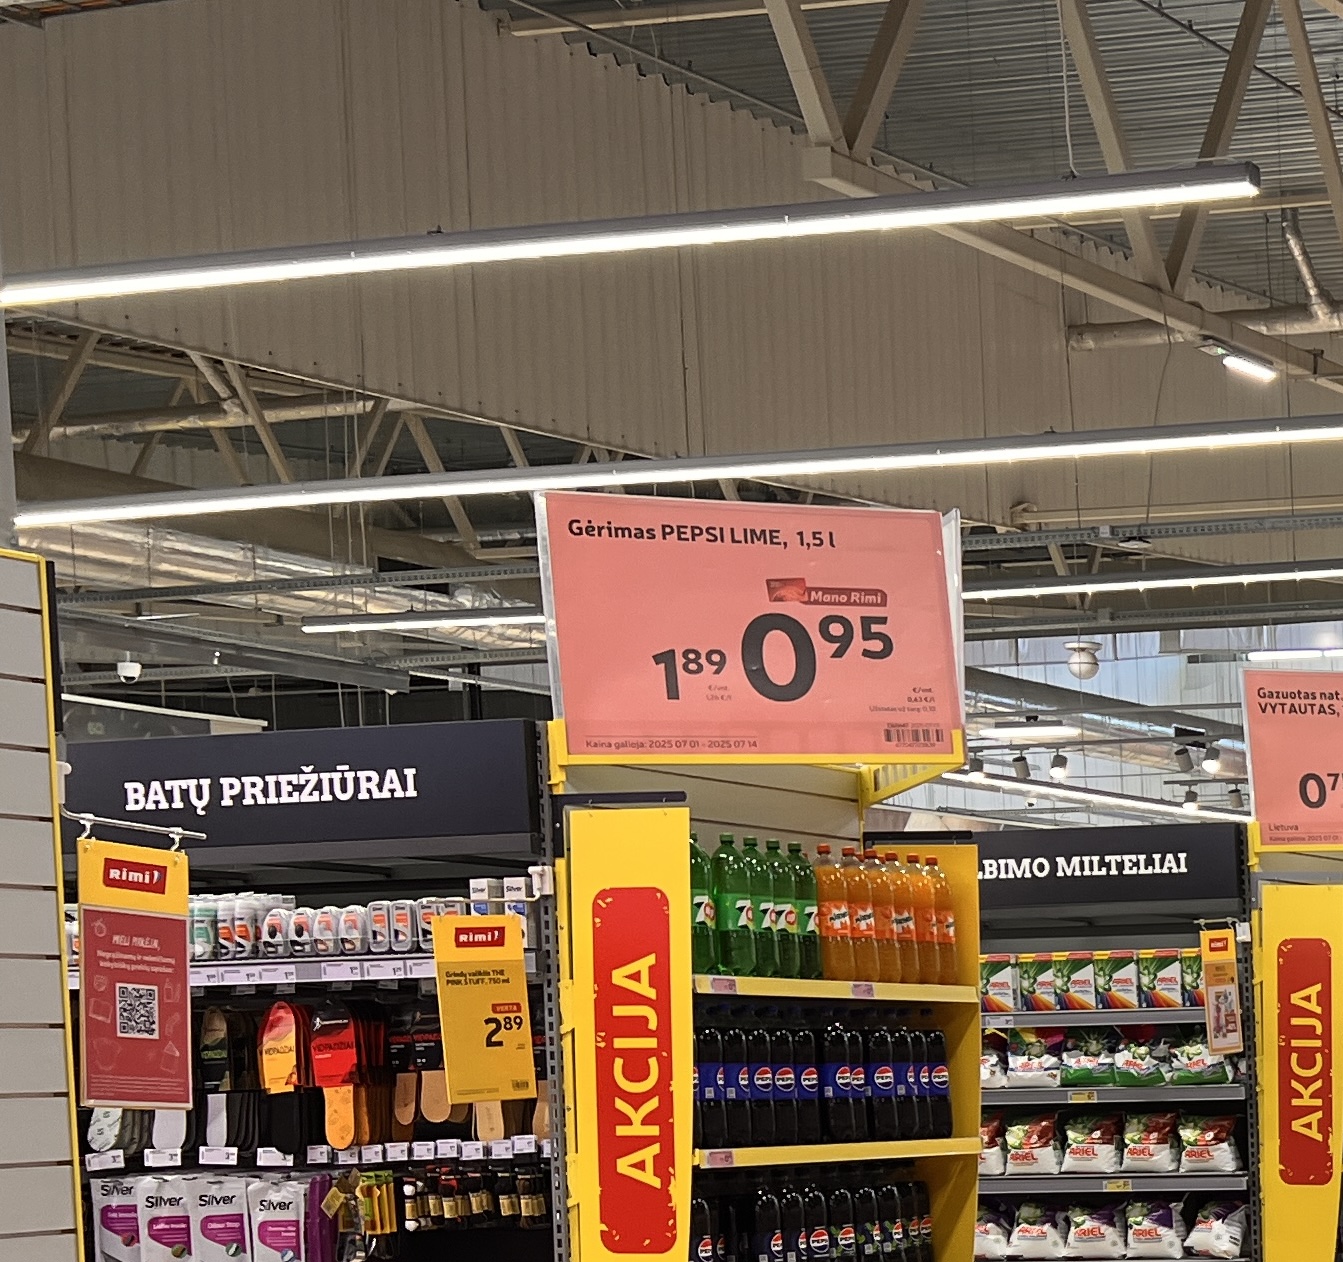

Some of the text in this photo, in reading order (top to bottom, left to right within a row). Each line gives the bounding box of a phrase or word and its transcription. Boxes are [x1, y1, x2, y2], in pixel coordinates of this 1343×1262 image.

[568, 518, 656, 541] Gėrimas
[661, 525, 725, 543] PEPSI
[730, 527, 789, 550] LIME,
[796, 530, 825, 548] 1,5
[810, 591, 883, 605] Mano Rimi
[652, 612, 895, 702] 189 095
[1257, 687, 1318, 701] Gazuotas
[1319, 691, 1343, 703] nat.
[1257, 702, 1341, 717] VYTAUTAS,
[648, 739, 672, 749] 2025
[707, 739, 731, 749] 2025
[124, 764, 418, 815] BATŲ PRIEŽIŪRAI
[1269, 823, 1299, 832] Lietuva
[978, 852, 1188, 880] BIMO MILTELIAI
[108, 867, 151, 885] Rimi
[458, 932, 492, 943] Rimi
[484, 1016, 524, 1048] 289
[1290, 982, 1324, 1143] AKCIJA
[611, 953, 662, 1190] AKCIJA
[100, 1184, 133, 1196] Silver
[145, 1196, 183, 1209] Silver
[199, 1194, 236, 1207] Silver
[259, 1200, 293, 1212] Silver
